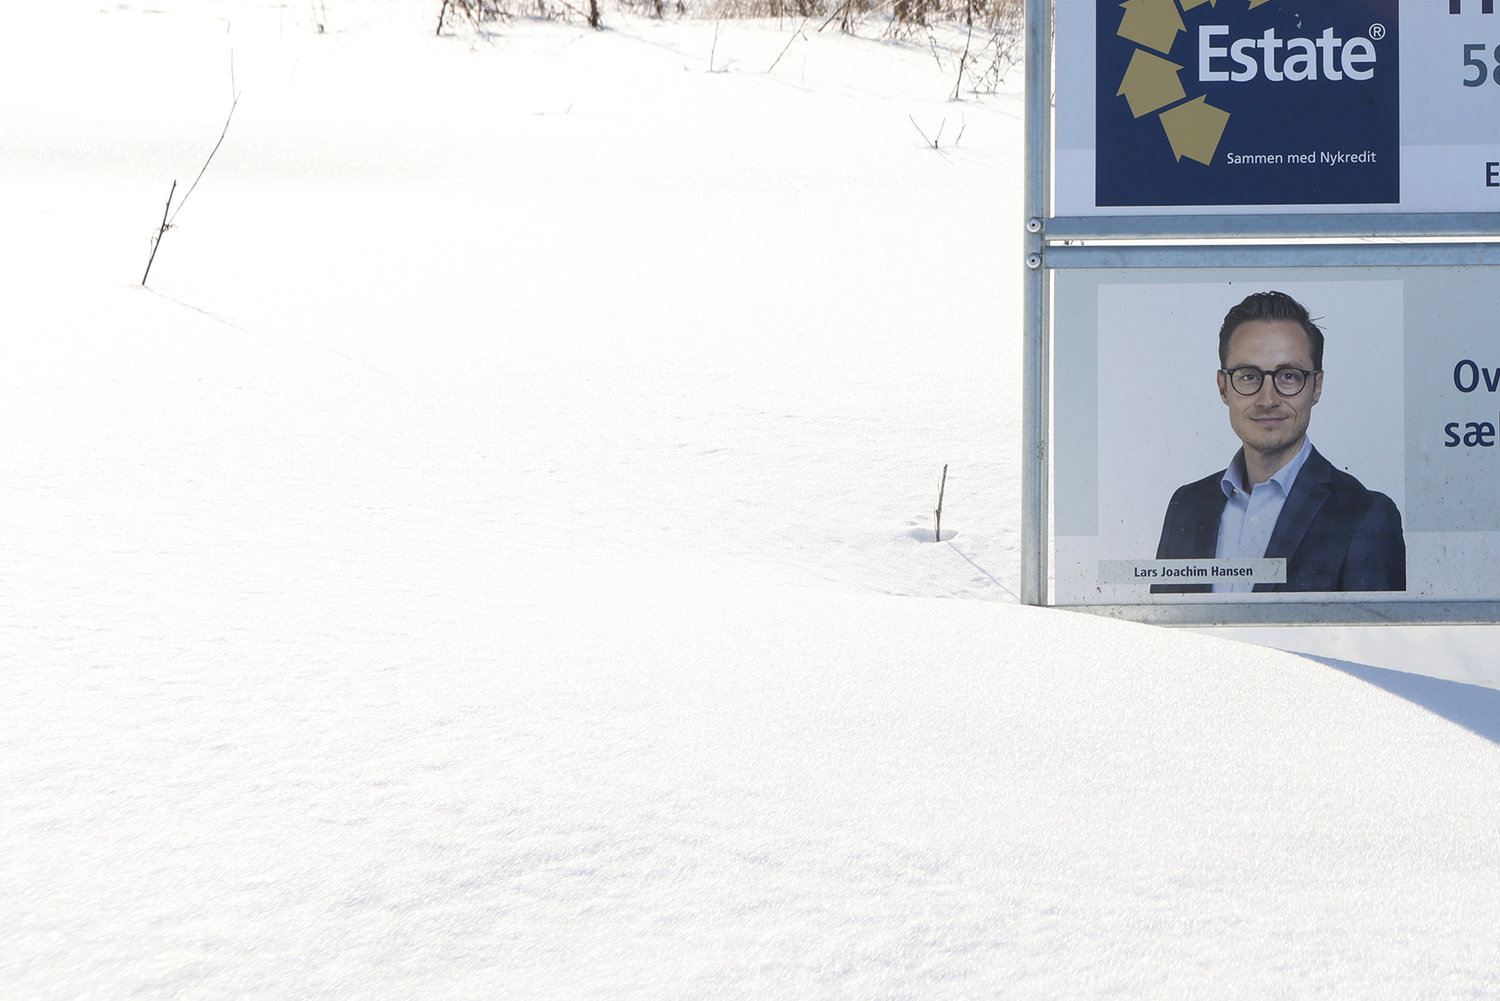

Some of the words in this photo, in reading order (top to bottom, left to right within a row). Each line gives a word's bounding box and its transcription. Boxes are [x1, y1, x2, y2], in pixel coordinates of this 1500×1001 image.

[1227, 152, 1283, 164] Sammen
[1287, 151, 1316, 164] med
[1320, 151, 1377, 166] Nykredit
[1134, 567, 1158, 577] Lars
[1161, 566, 1208, 577] Joachim
[1211, 566, 1253, 576] Hansen
